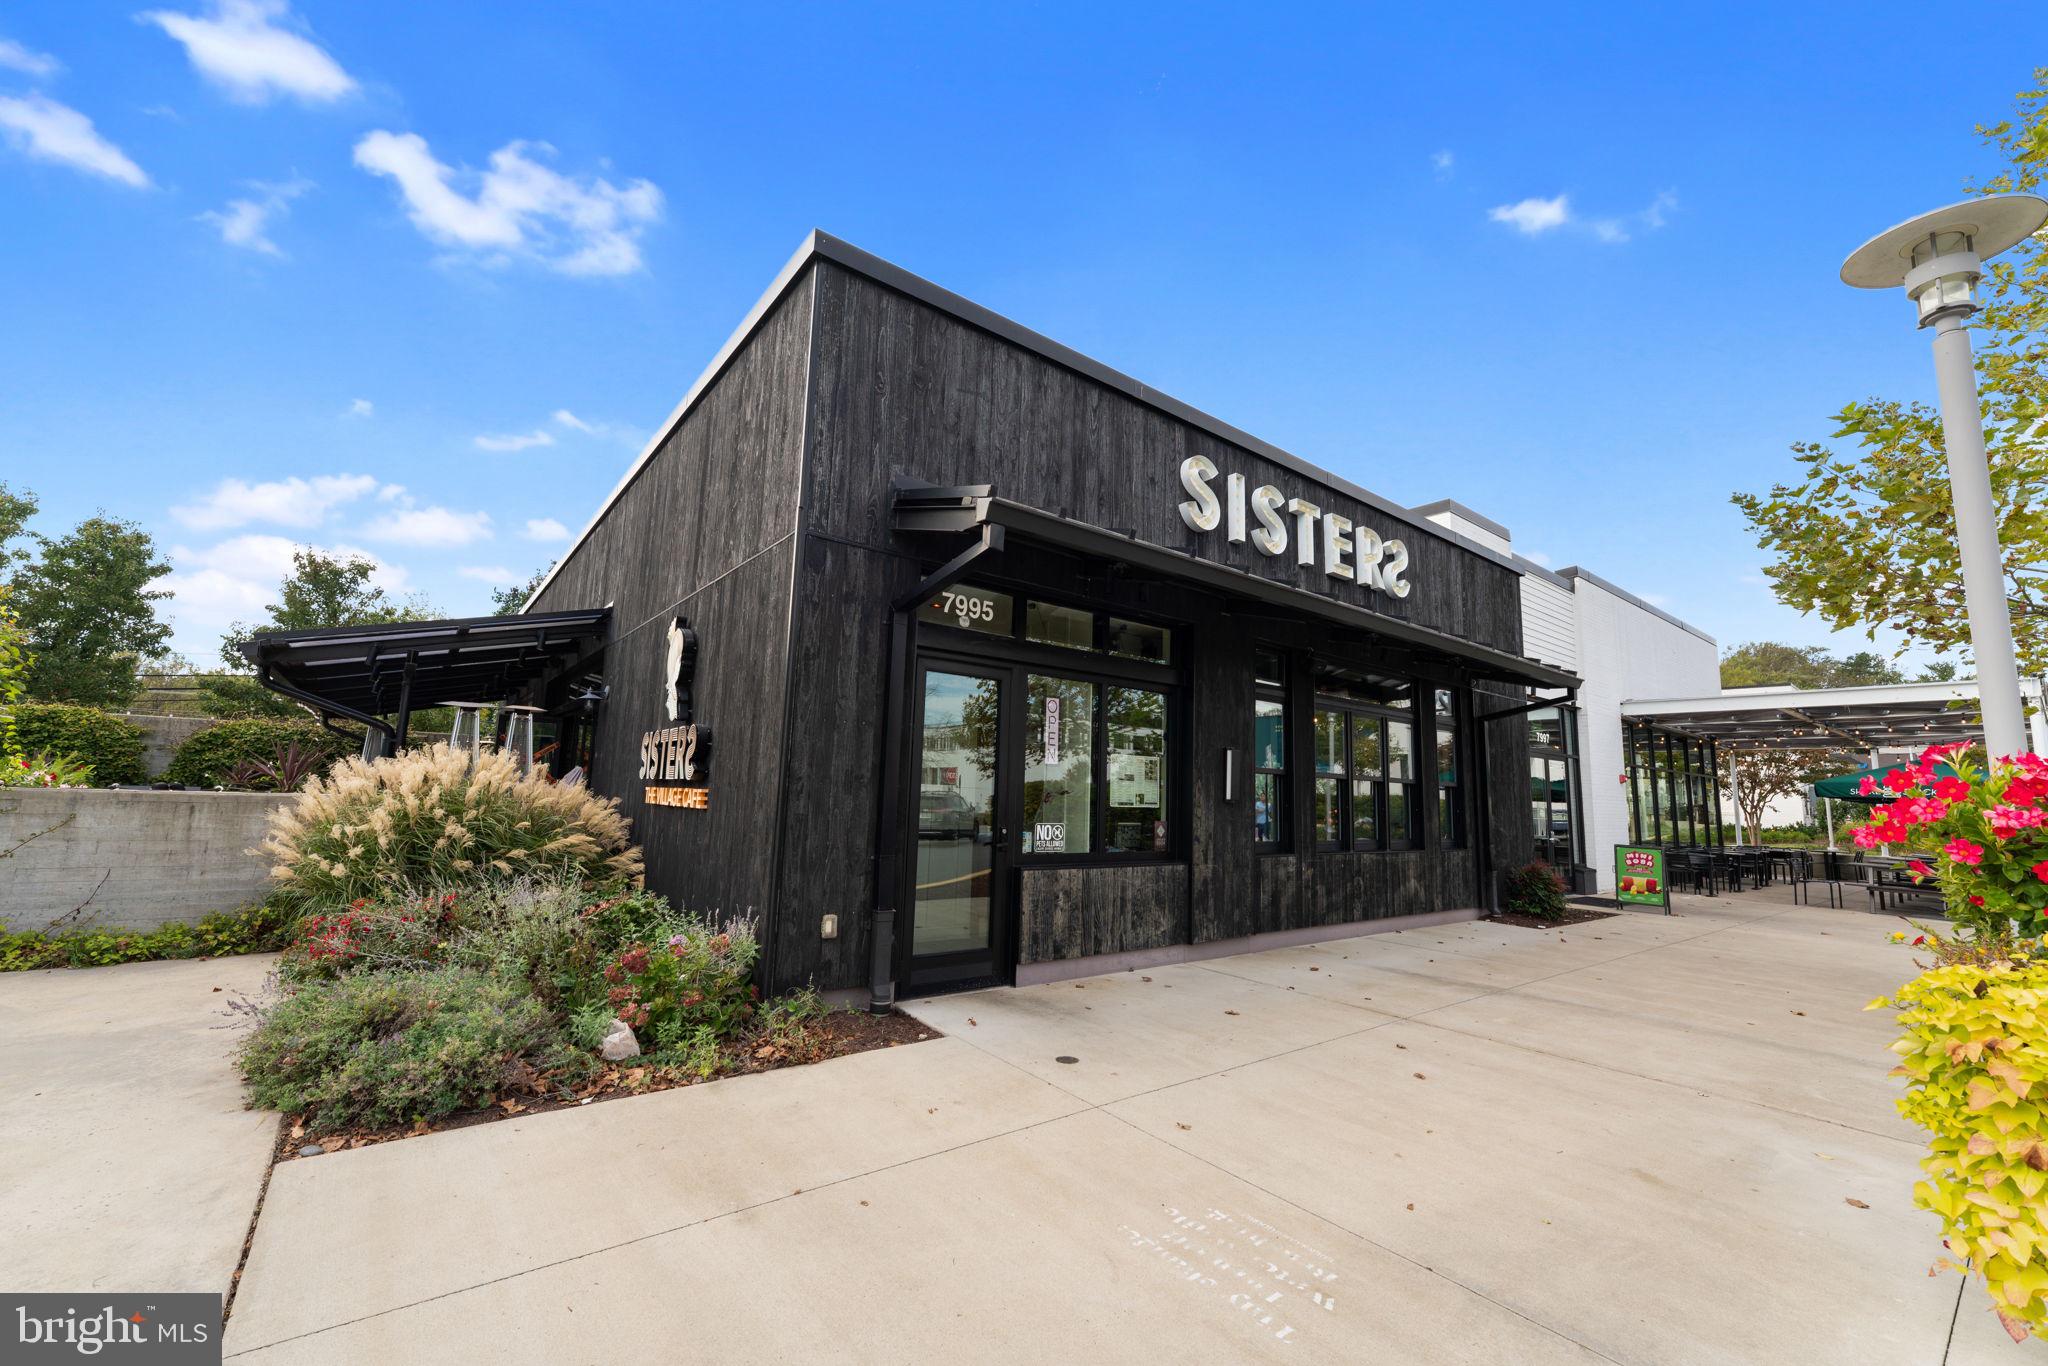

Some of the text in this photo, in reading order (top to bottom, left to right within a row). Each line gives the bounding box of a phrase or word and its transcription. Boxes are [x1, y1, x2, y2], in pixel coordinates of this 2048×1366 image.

[1178, 454, 1411, 599] SISTERS
[942, 592, 994, 622] 7995
[1047, 699, 1058, 762] OPEN
[1536, 732, 1550, 743] 7997
[639, 723, 698, 781] SISTERS
[645, 786, 657, 804] THE
[656, 787, 683, 807] VILLAGE
[1036, 825, 1052, 841] NO
[1626, 852, 1653, 861] MINI
